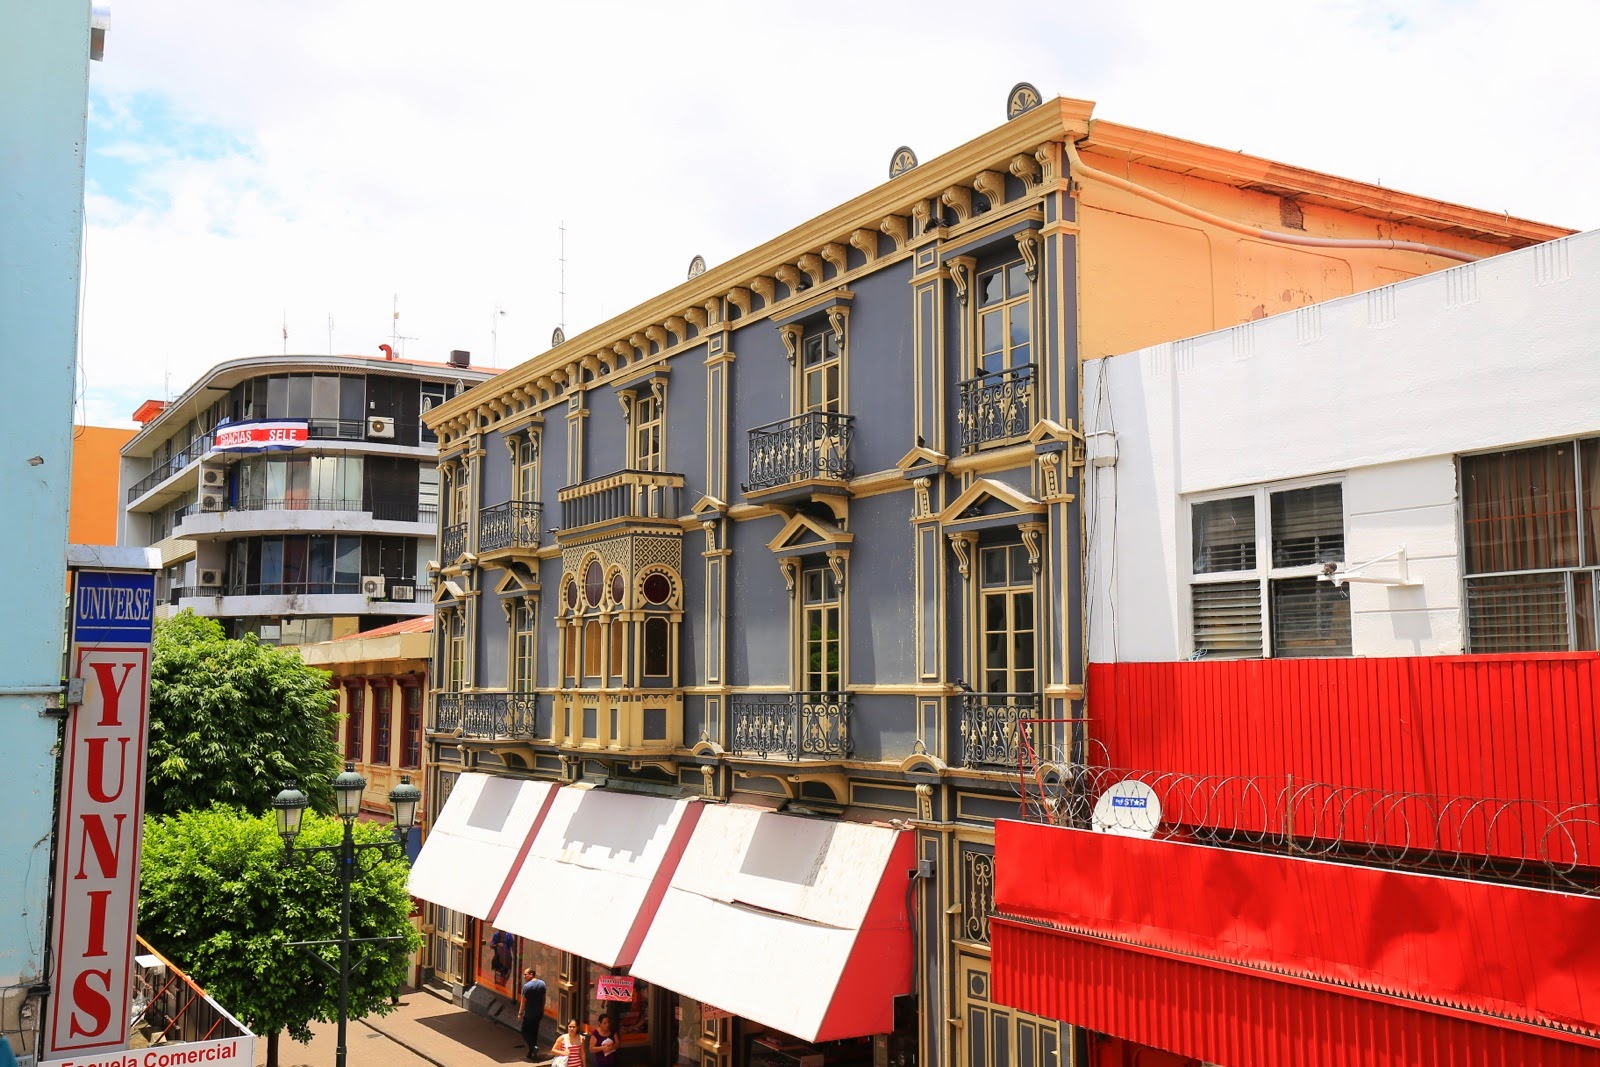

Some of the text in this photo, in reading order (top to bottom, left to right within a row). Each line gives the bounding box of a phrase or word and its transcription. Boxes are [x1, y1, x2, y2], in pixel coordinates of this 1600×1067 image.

[220, 429, 297, 446] GRACIAS SELE
[79, 586, 151, 620] UNIVERSE
[69, 662, 136, 1038] YUNIS
[598, 985, 632, 997] ANA
[143, 1041, 236, 1067] Comercial
